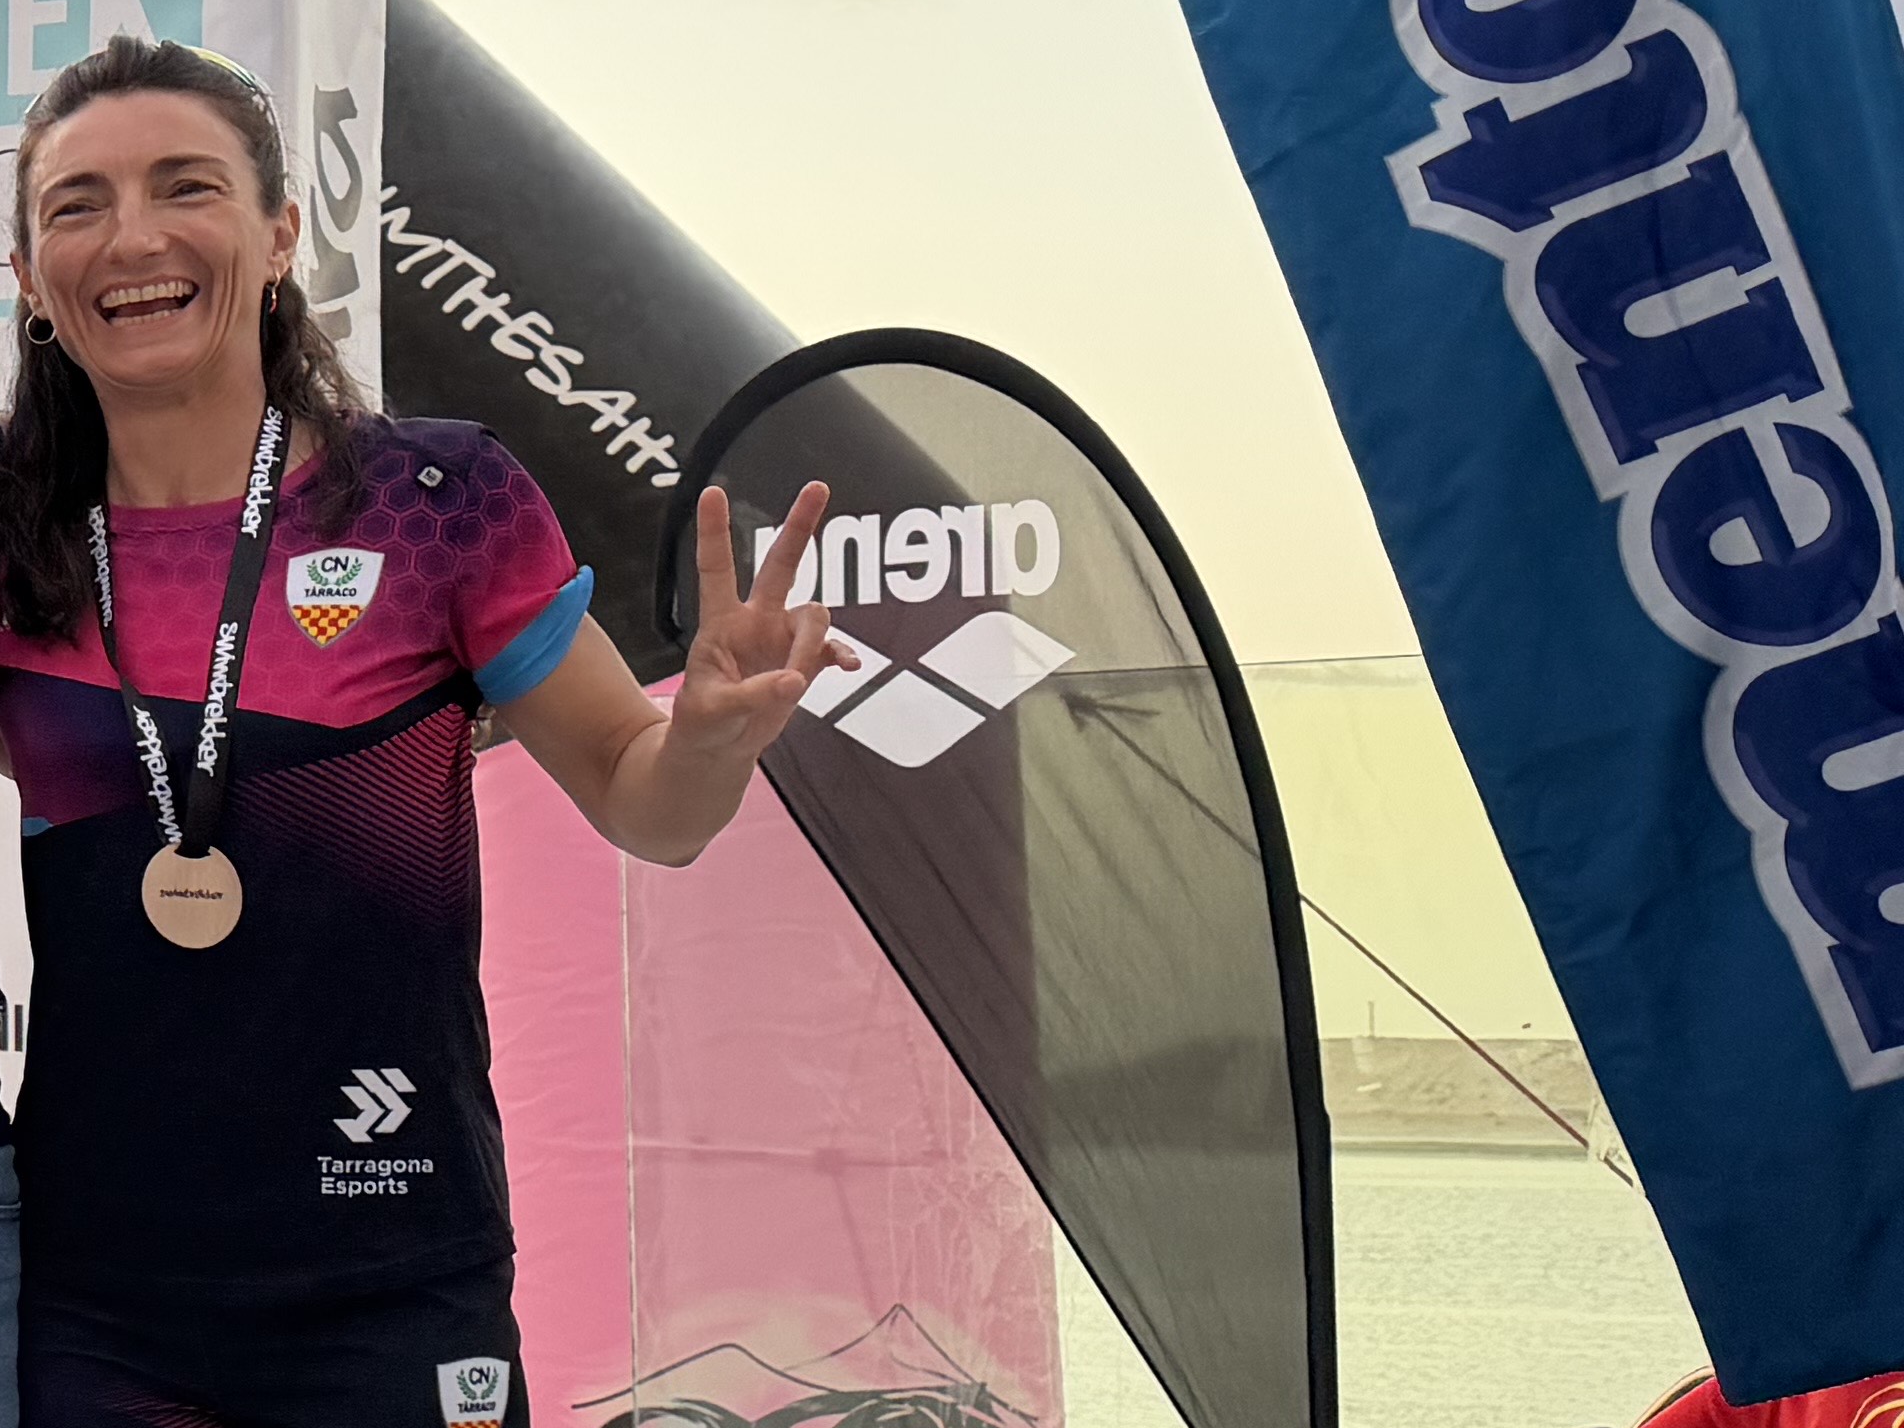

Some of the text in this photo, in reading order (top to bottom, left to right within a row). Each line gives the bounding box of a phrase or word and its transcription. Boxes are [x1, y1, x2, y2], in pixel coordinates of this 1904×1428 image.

[321, 556, 349, 572] CN
[133, 704, 183, 845] wimtrekker
[317, 1155, 434, 1180] Tarragona
[321, 1177, 409, 1199] Esports
[469, 1368, 490, 1386] CN
